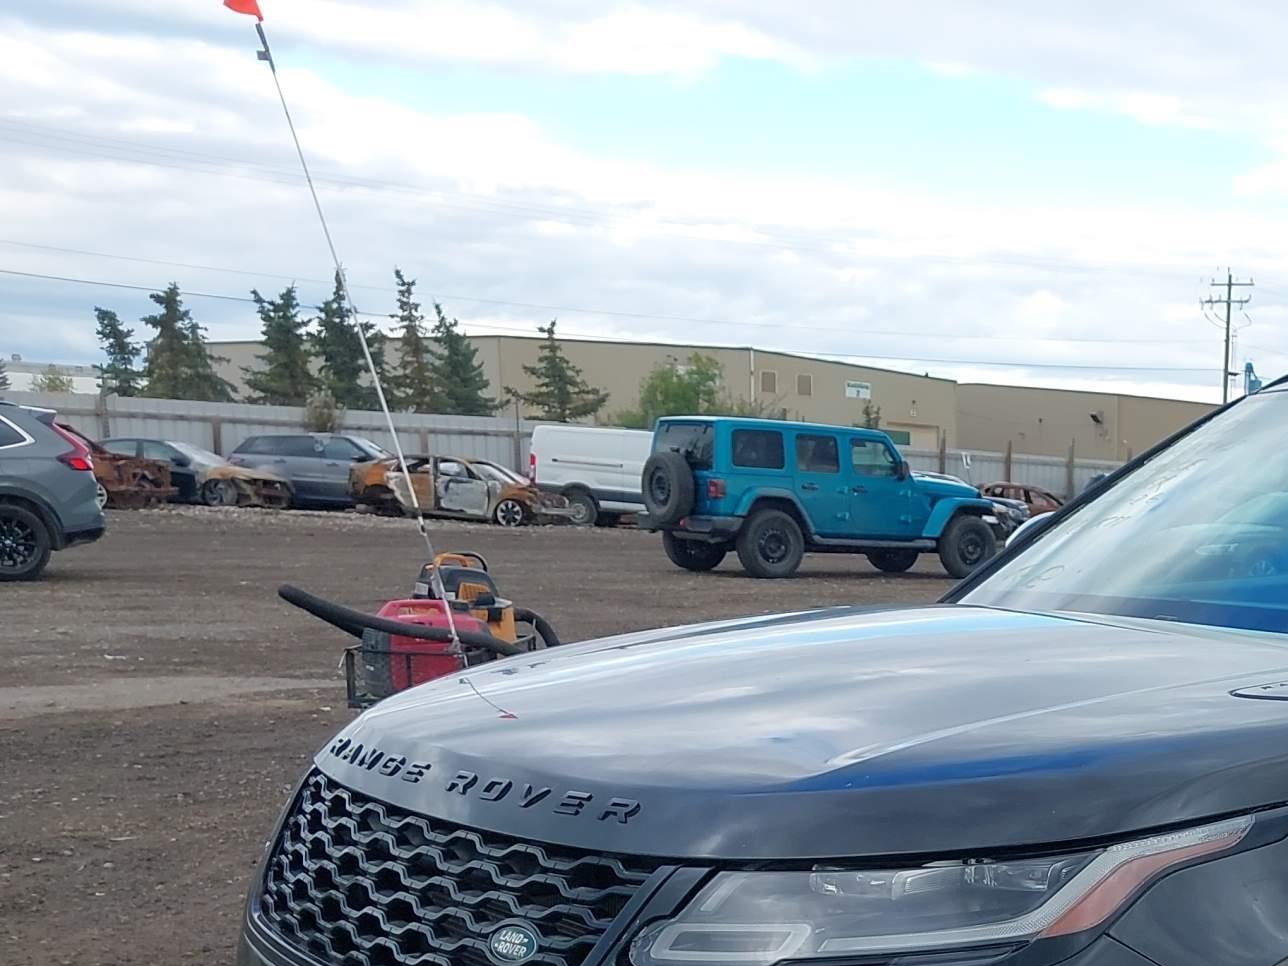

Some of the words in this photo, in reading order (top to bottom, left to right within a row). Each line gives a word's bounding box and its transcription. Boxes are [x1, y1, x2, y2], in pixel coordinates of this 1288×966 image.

[330, 738, 432, 783] RANGE
[446, 769, 641, 825] ROVER
[497, 941, 527, 957] ROVER
